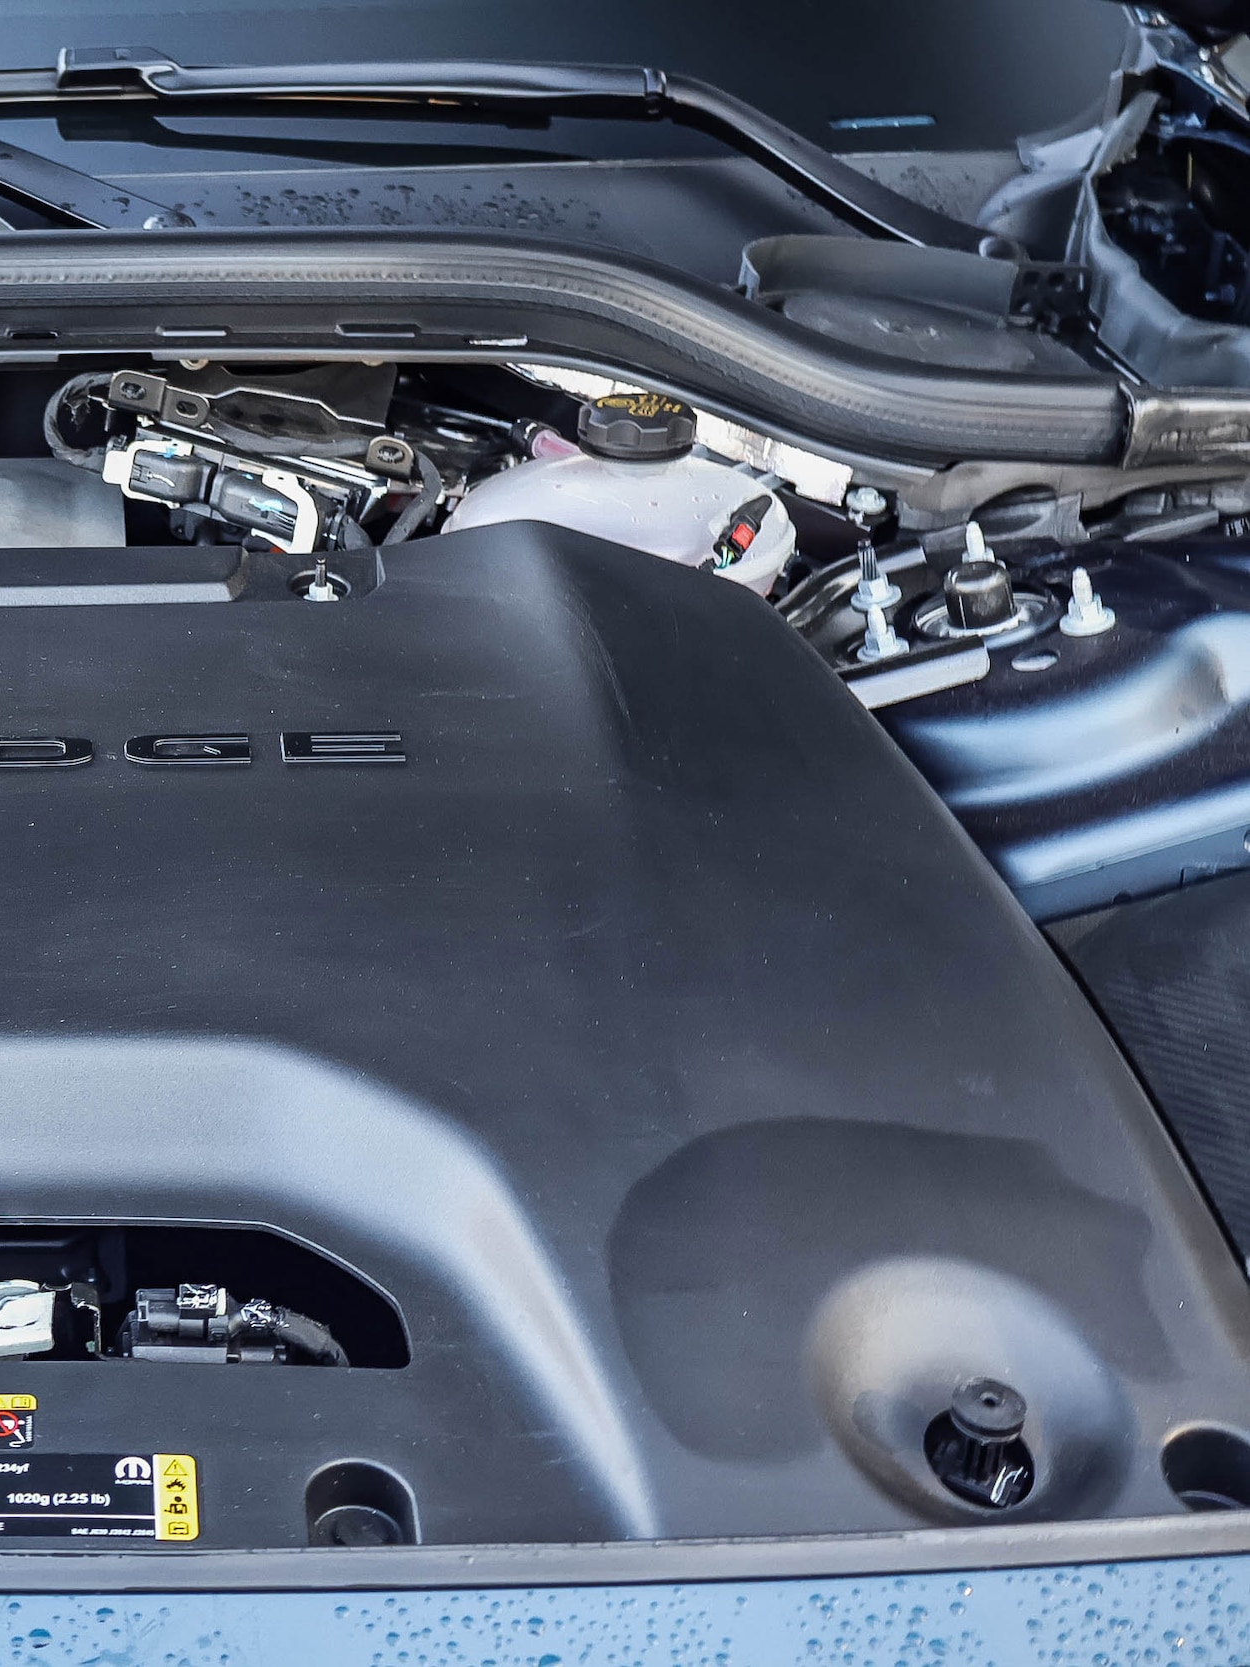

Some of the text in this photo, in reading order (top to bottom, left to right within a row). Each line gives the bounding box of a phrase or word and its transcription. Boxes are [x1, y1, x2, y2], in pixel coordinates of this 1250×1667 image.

[6, 1492, 111, 1507] 1020g (2.25 lb)
